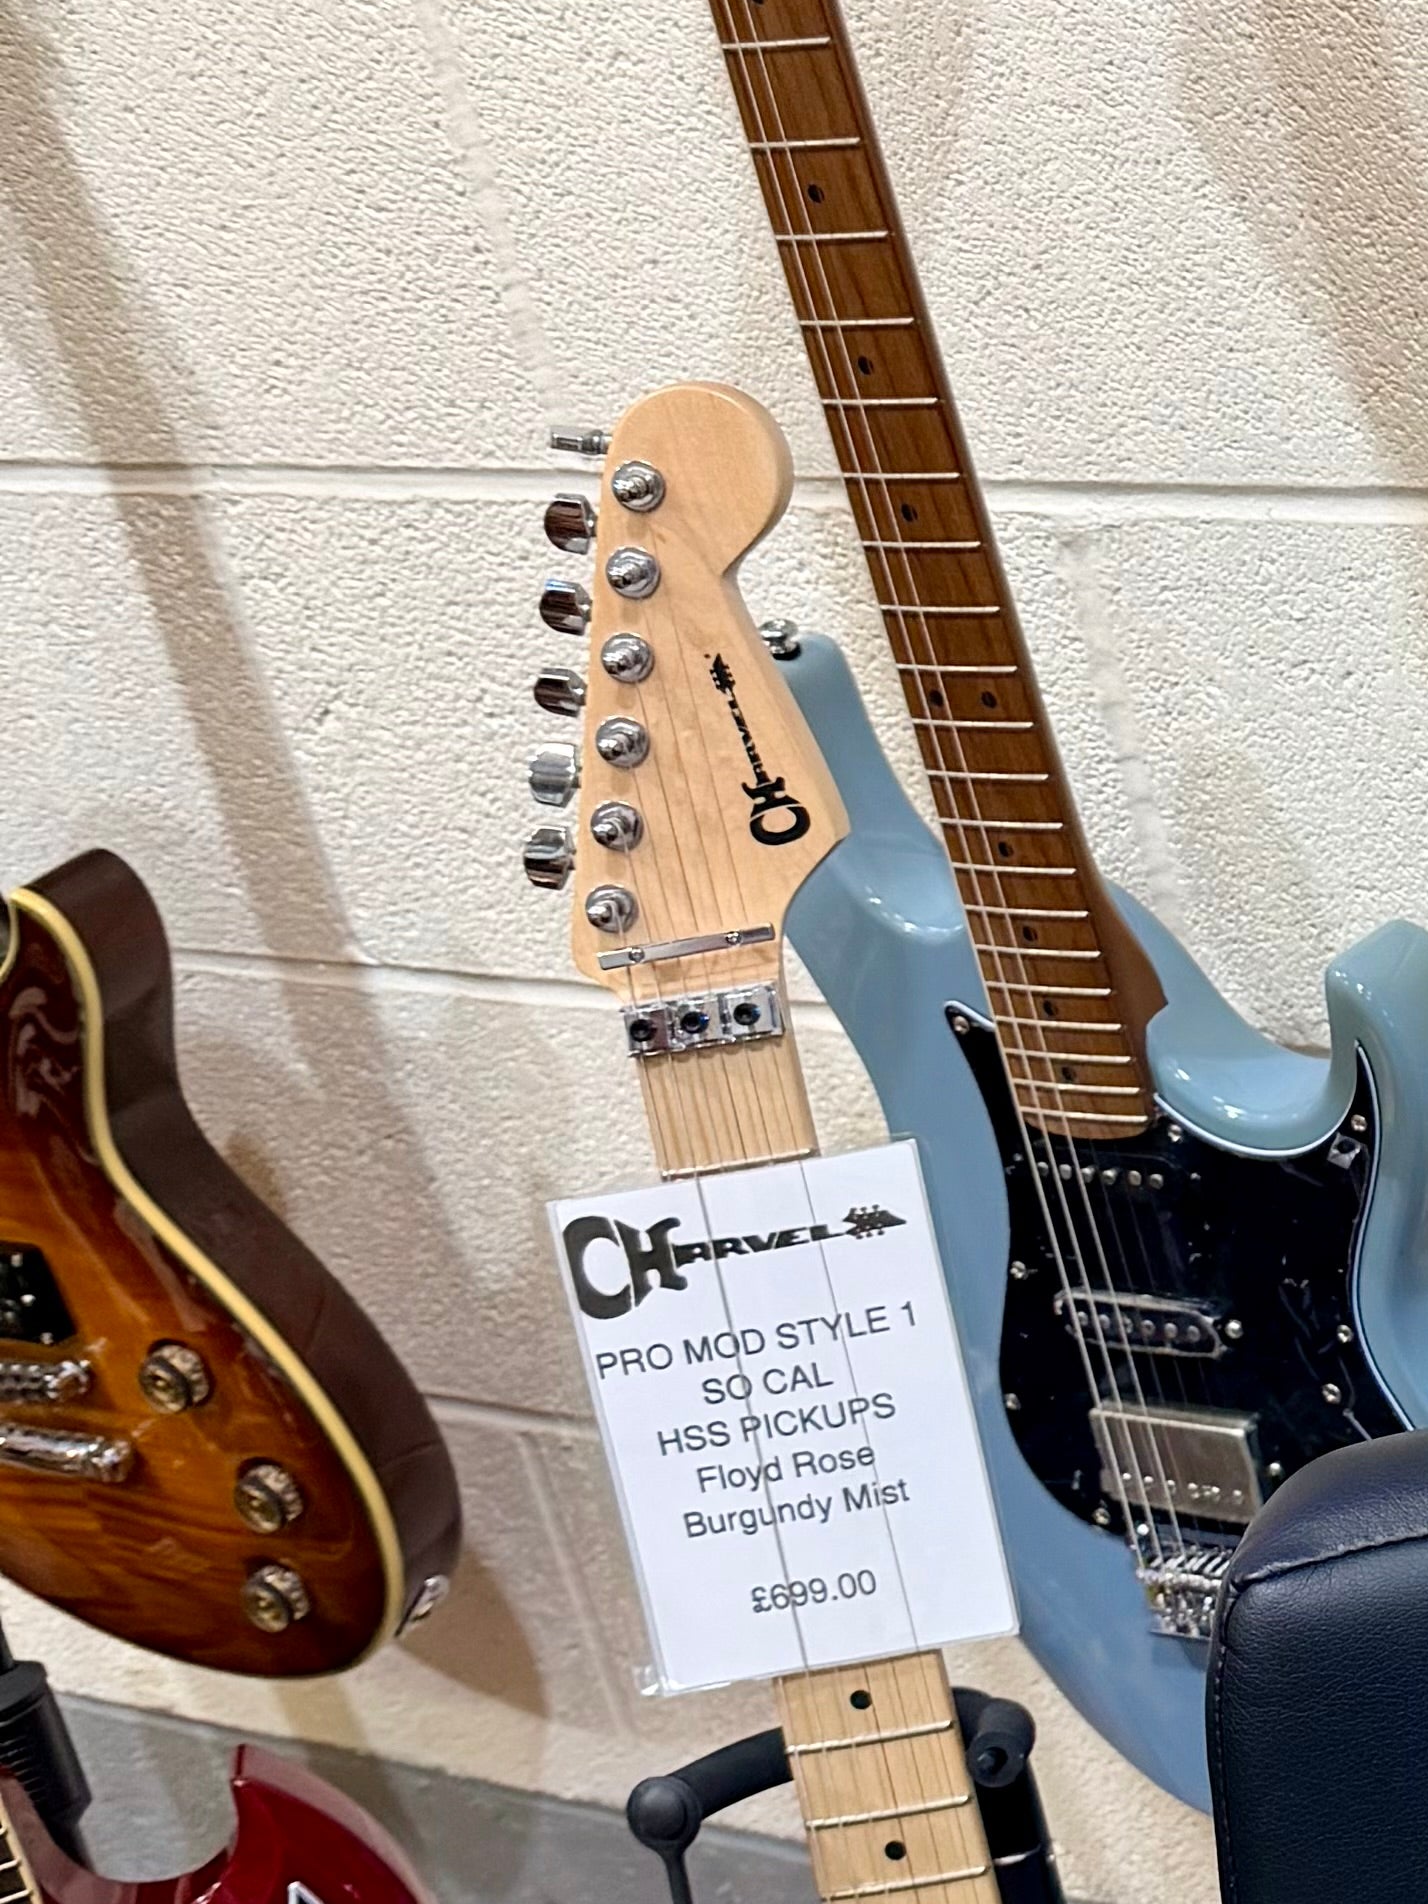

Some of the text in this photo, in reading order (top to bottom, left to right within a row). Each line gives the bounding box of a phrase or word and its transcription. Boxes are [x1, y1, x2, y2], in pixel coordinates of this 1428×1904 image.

[596, 1301, 916, 1380] PRO MOD STYLE 1
[702, 1362, 834, 1405] SO CAL
[657, 1392, 896, 1456] HSS PICKUPS
[697, 1446, 876, 1494] Floyd Rose
[683, 1478, 911, 1539] Burgundy Mist
[750, 1568, 877, 1614] £699.00
